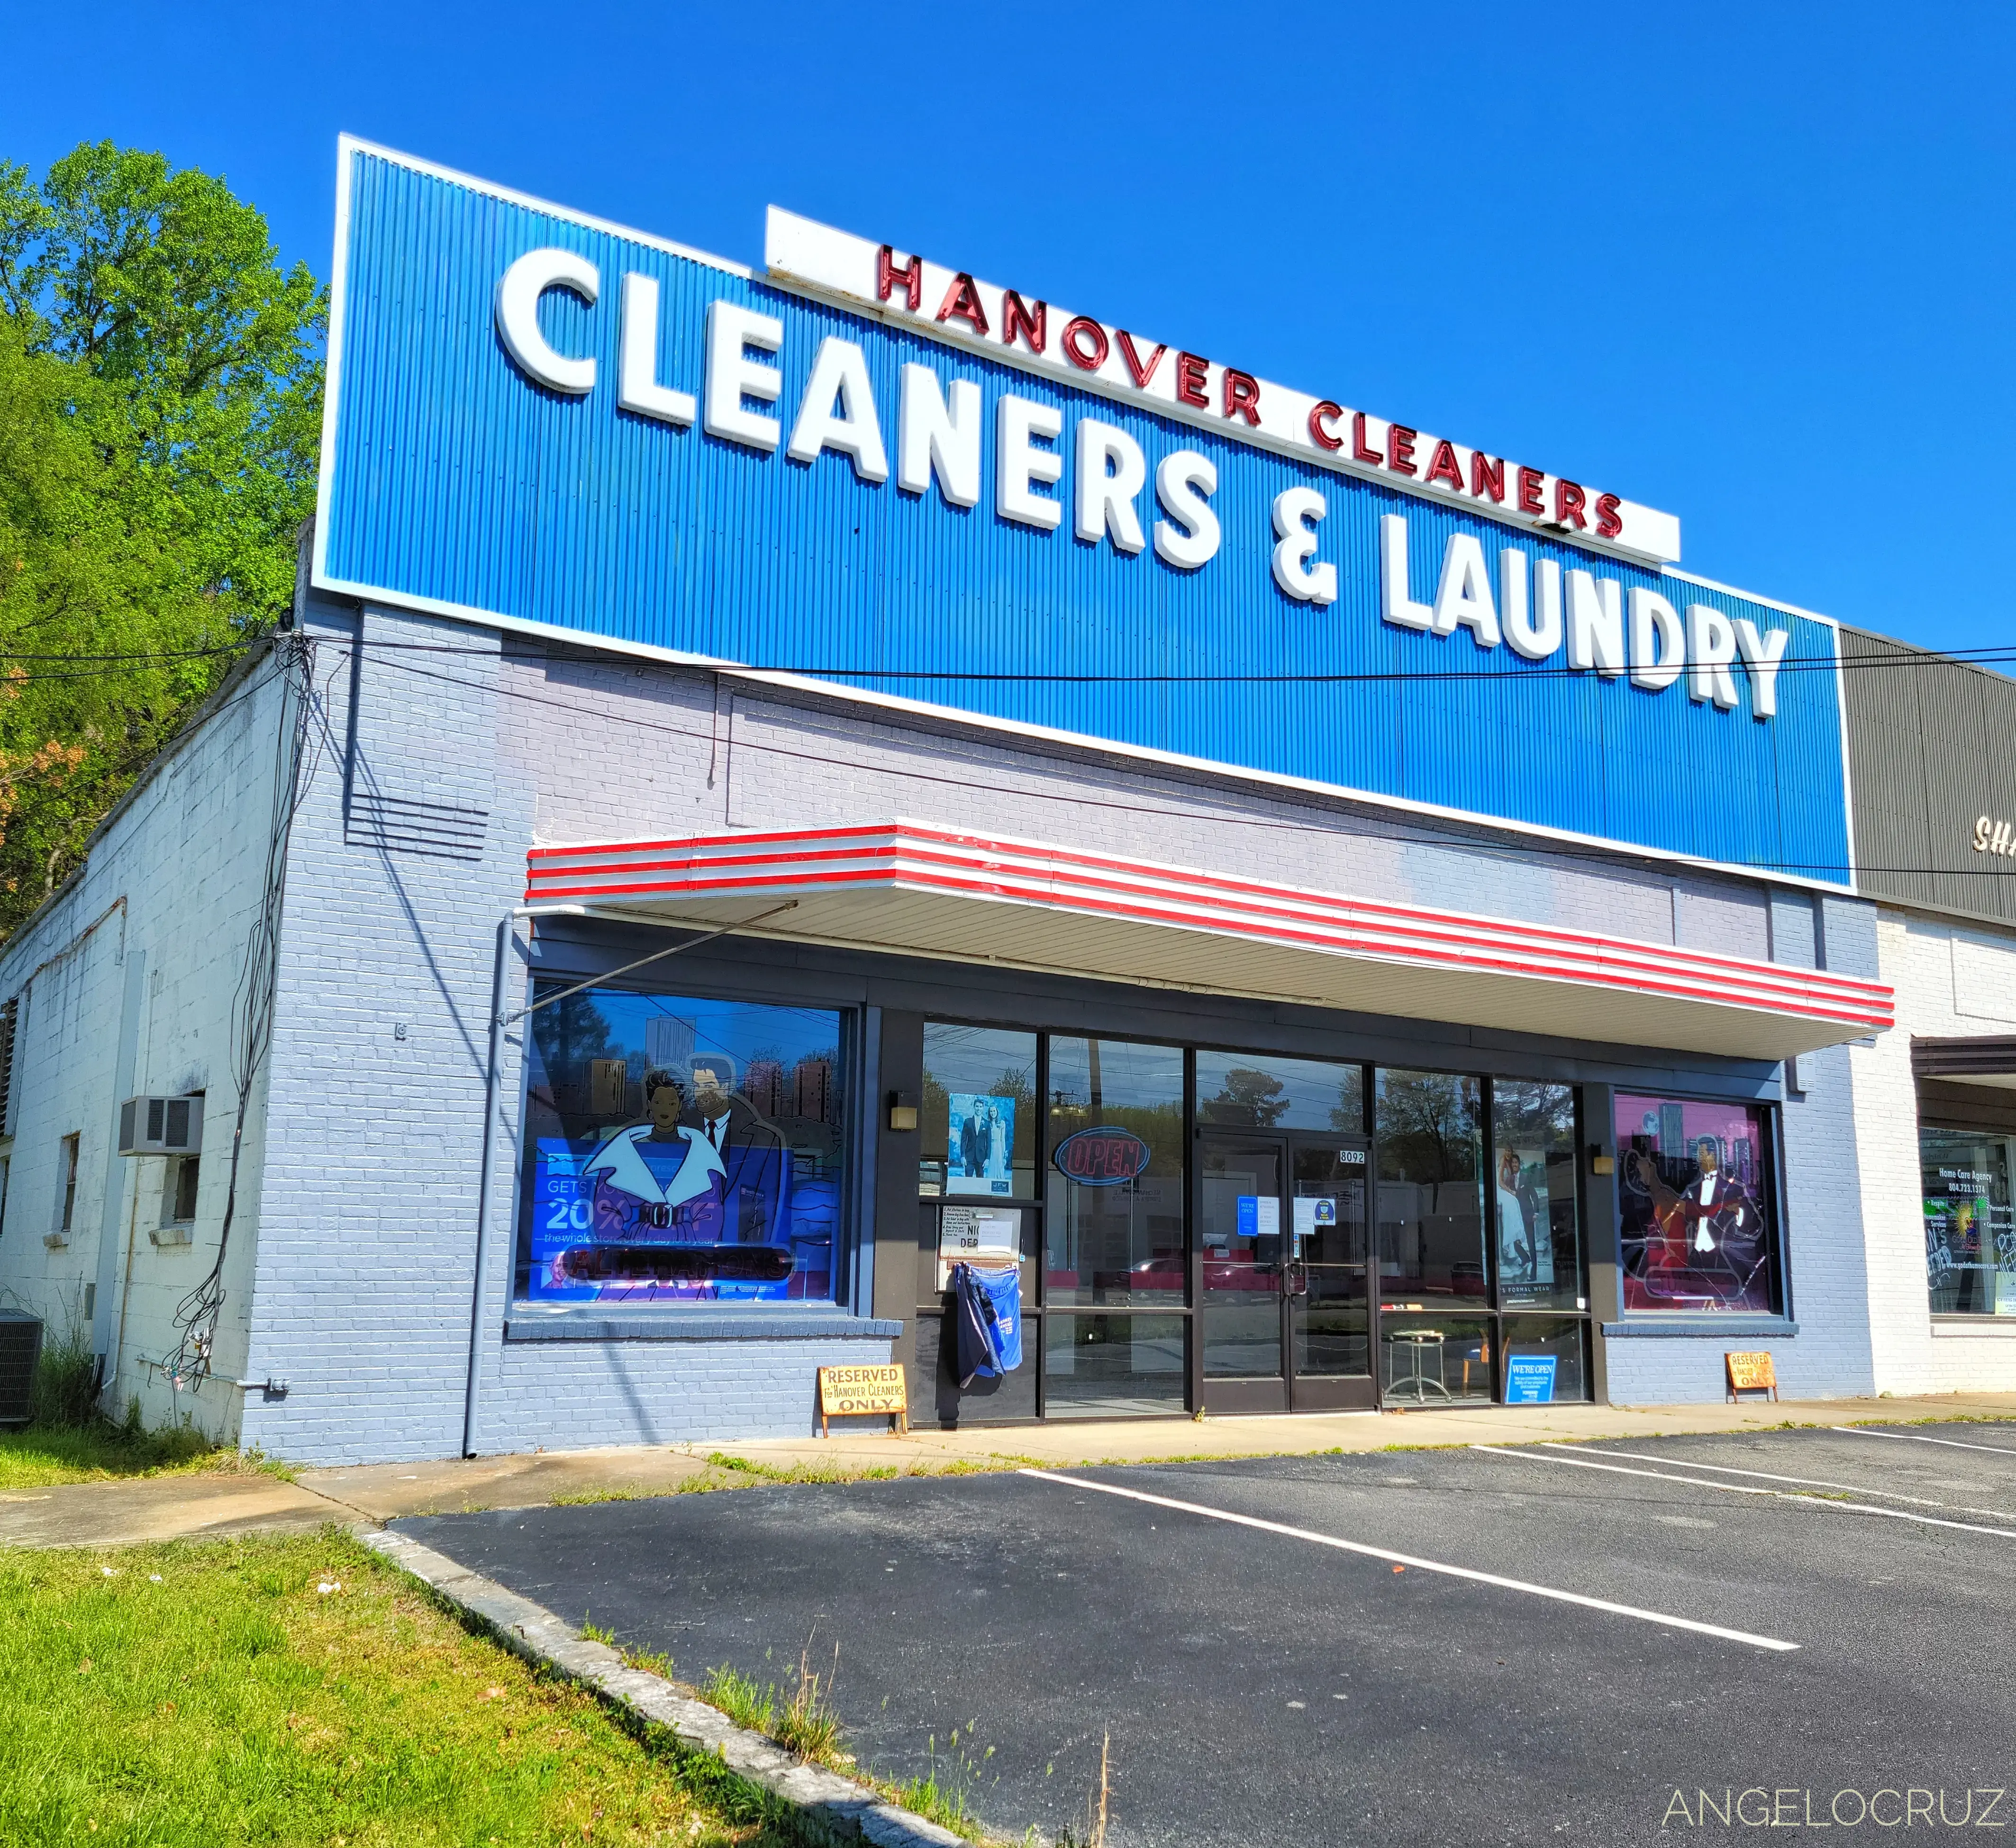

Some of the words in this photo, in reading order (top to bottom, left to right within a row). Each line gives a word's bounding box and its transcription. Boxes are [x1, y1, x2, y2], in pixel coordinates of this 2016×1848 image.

[876, 244, 1262, 426] HANOVER
[1308, 401, 1623, 538] CLEANERS
[496, 248, 1221, 569] CLEANERS
[1272, 487, 1337, 605] &
[1380, 515, 1789, 719] LAUNDRY
[1068, 1139, 1139, 1177] OPEN
[1341, 1152, 1363, 1162] 8092
[1939, 1168, 1956, 1178] Home
[1957, 1169, 1970, 1179] Care
[1972, 1170, 1992, 1183] Agency
[548, 1180, 587, 1193] GETS
[1949, 1183, 1985, 1194] 804.723.1374
[546, 1197, 628, 1231] 20%
[967, 1225, 980, 1235] NI
[545, 1234, 561, 1242] the
[563, 1233, 591, 1242] whole
[653, 1235, 670, 1245] day
[692, 1236, 714, 1246] year
[570, 1249, 786, 1277] ALTERATIONS
[1732, 1355, 1769, 1365] RESERVED
[828, 1368, 898, 1384] RESERVED
[1512, 1365, 1535, 1374] WE'RE
[1535, 1365, 1553, 1374] OPEN
[1741, 1377, 1769, 1386] ONLY
[834, 1385, 865, 1398] HANOVER
[868, 1383, 904, 1396] CLEANERS
[839, 1399, 893, 1411] ONLY
